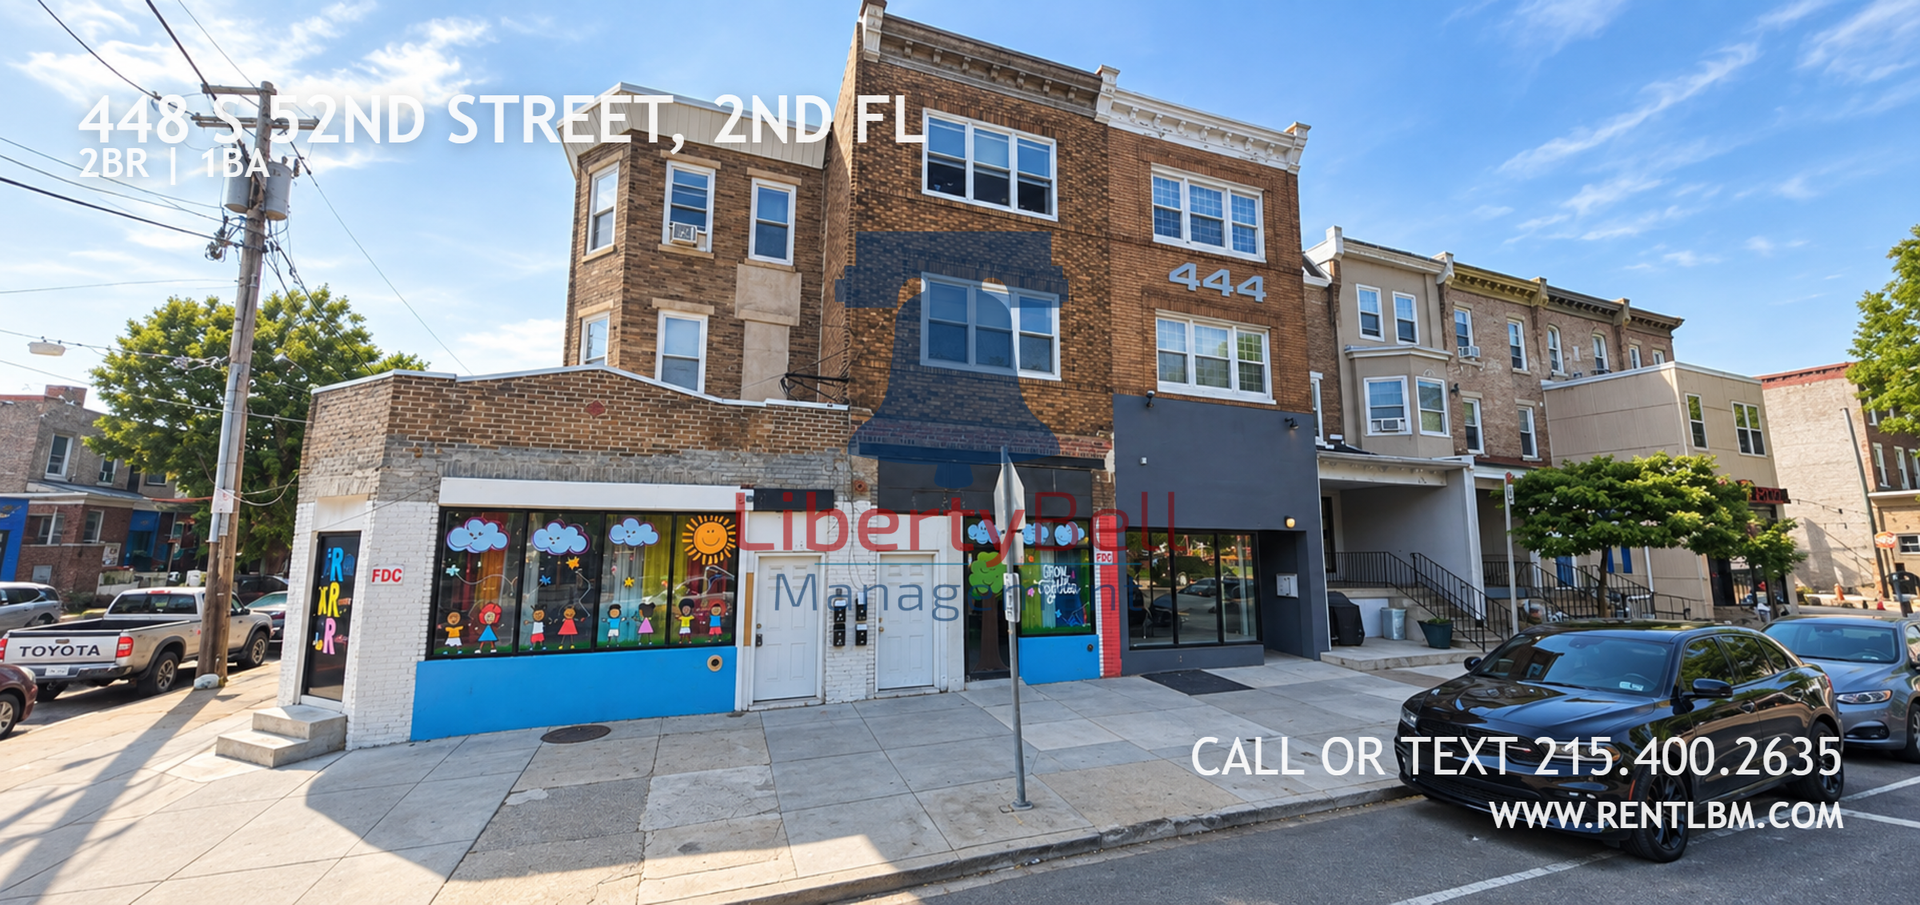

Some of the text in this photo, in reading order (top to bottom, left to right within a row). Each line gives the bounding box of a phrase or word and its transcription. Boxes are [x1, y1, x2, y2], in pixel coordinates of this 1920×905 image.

[1168, 262, 1268, 303] 444
[371, 568, 403, 583] FDC
[19, 645, 100, 657] TOYOTA
